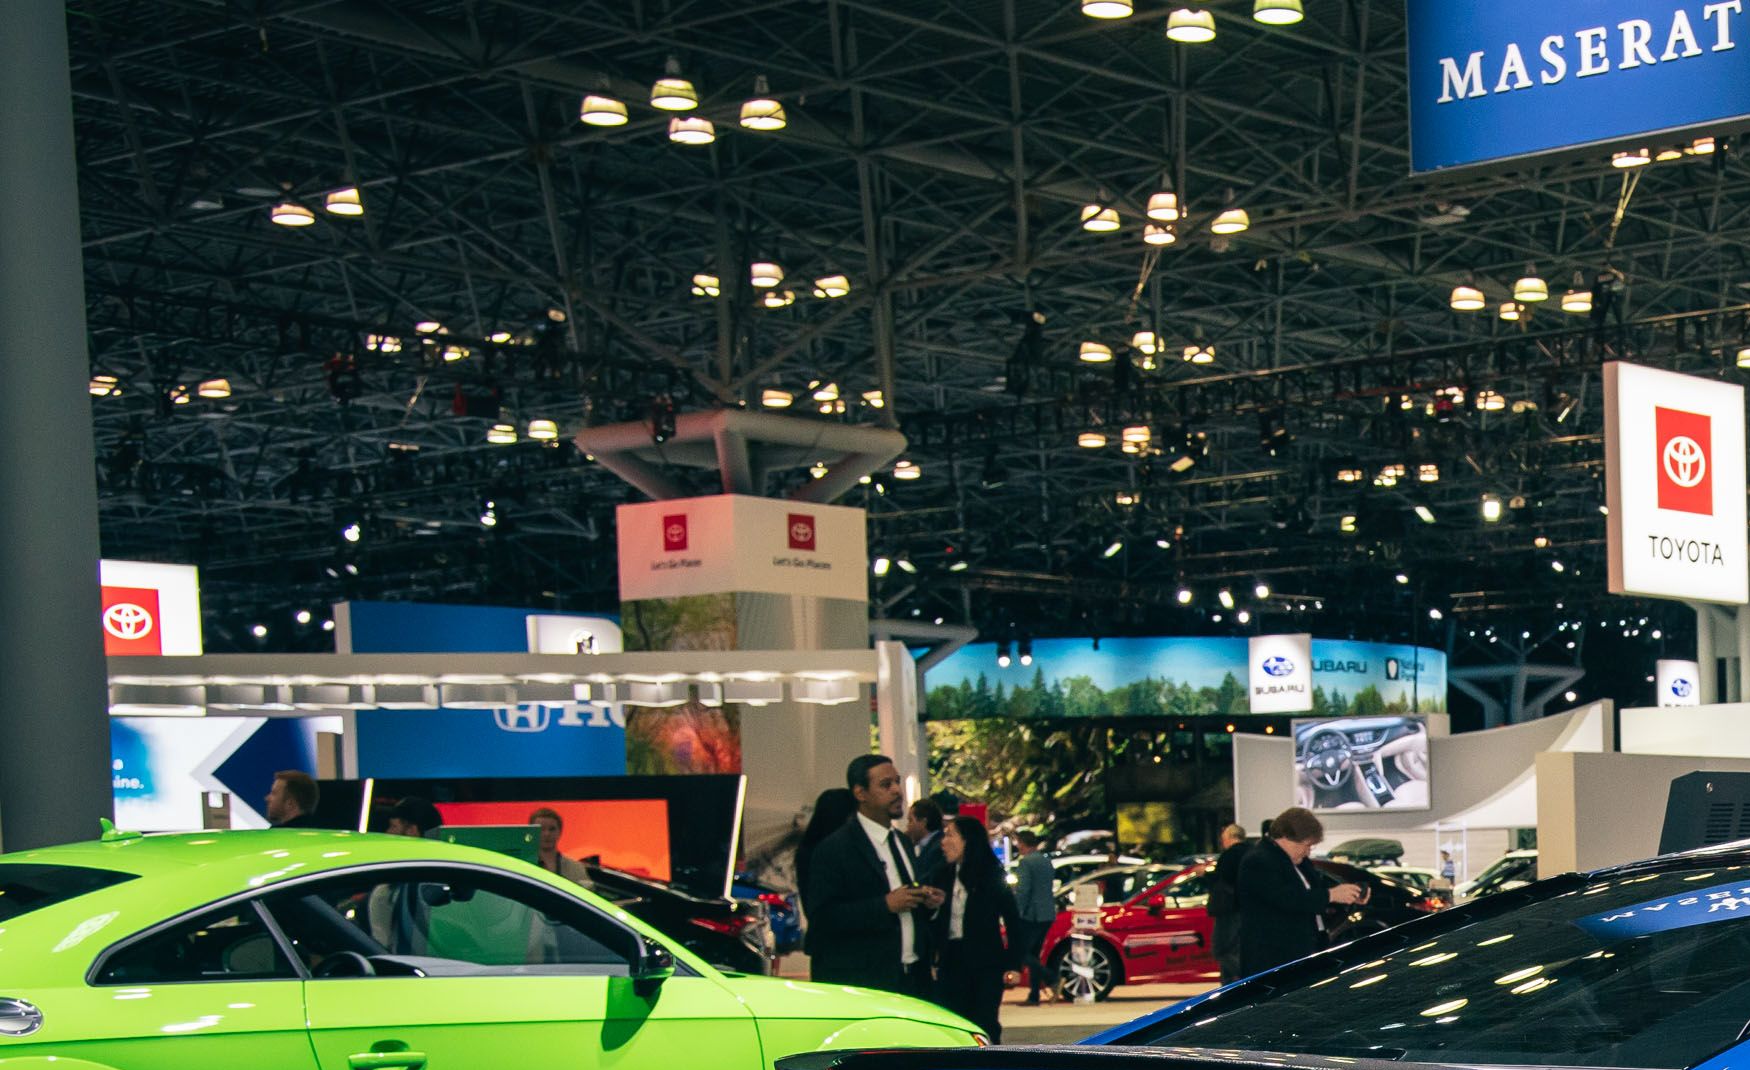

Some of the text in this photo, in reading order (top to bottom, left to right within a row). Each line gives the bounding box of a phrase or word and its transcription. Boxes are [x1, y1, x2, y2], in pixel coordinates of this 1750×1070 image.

[1648, 535, 1724, 566] TOYOTA
[1312, 660, 1368, 674] UBARU
[1255, 684, 1305, 695] SUBARU
